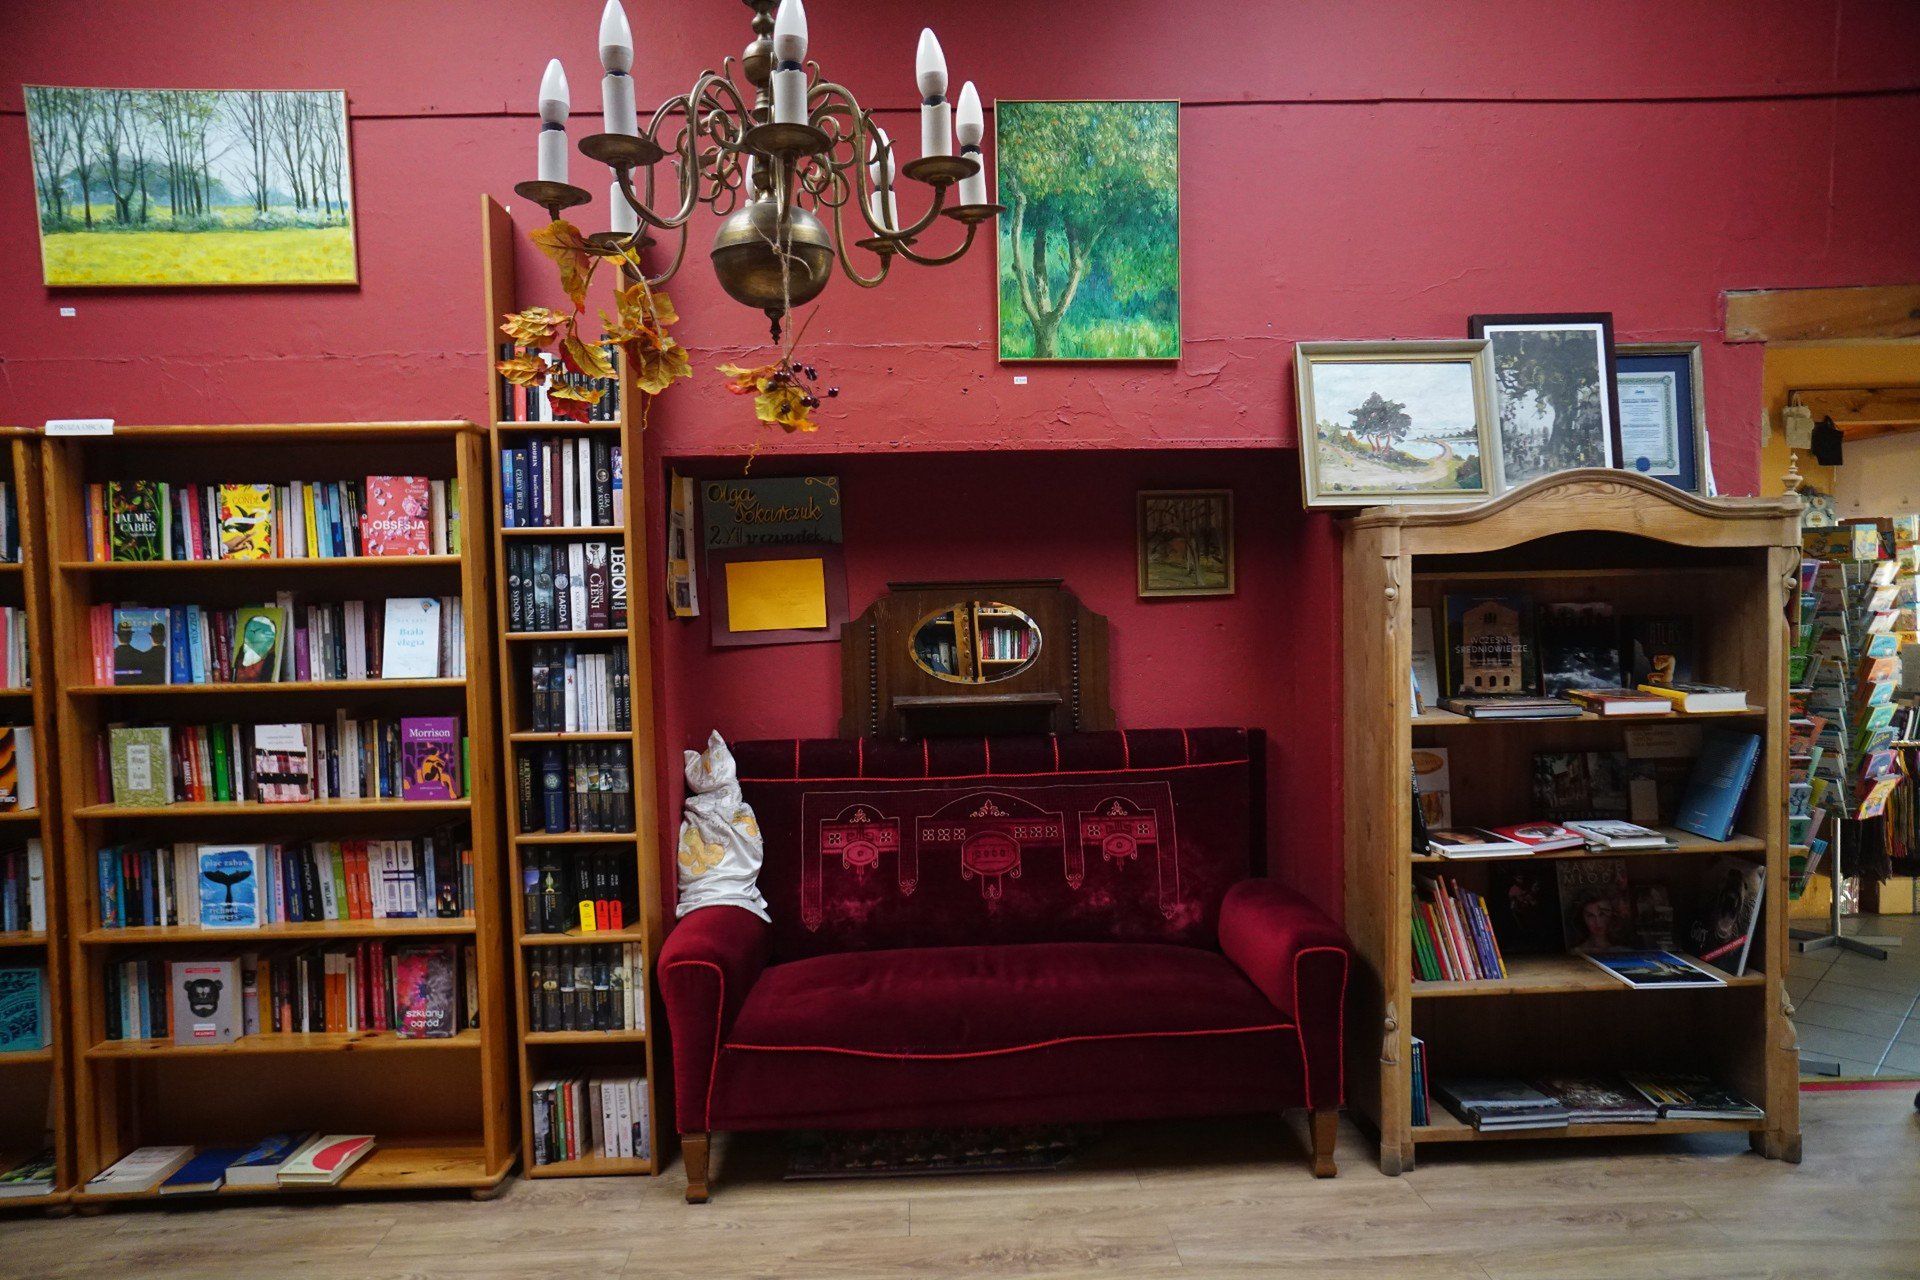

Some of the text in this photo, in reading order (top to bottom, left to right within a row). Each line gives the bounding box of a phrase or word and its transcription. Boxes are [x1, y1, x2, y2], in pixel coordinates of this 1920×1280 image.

[707, 481, 757, 509] Olga
[734, 495, 824, 524] Tokarczuk
[115, 513, 152, 524] JAUME
[373, 520, 425, 530] OBSESJA
[610, 546, 626, 599] LEGION
[590, 573, 602, 609] CIENI
[513, 590, 521, 622] SYDONIA
[527, 593, 535, 625] SYDONIA
[558, 591, 567, 623] HARDA
[399, 628, 424, 636] Biała
[1470, 635, 1513, 644] WCZESNE
[1454, 644, 1528, 654] ŚREDNIOWIECZE
[409, 728, 451, 737] Morrison
[183, 761, 192, 785] MANKELL
[524, 774, 532, 801] TOLKIEN
[225, 859, 249, 867] zabaw
[406, 1010, 444, 1019] szklany
[411, 1019, 440, 1028] ogród
